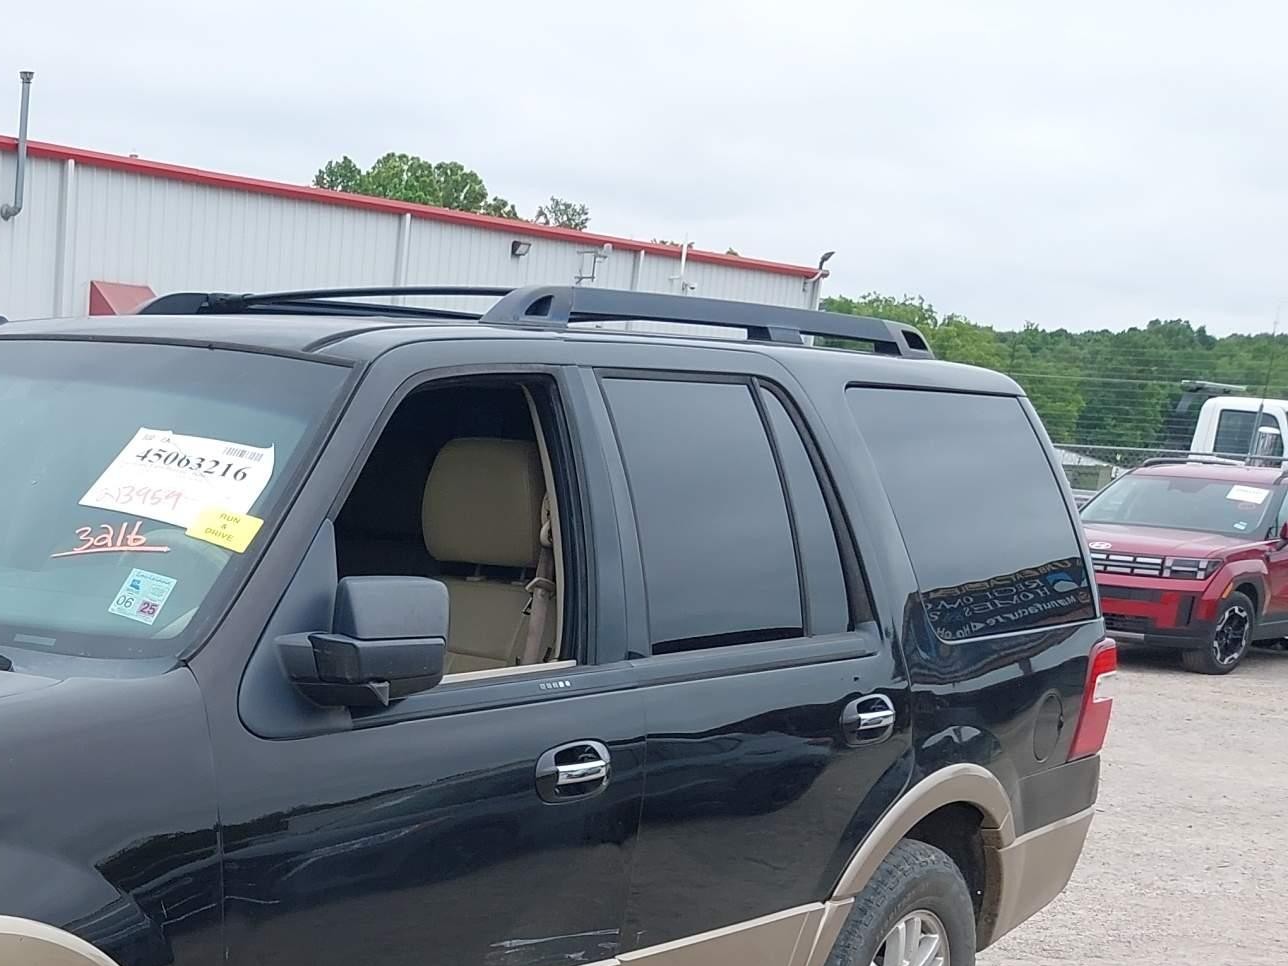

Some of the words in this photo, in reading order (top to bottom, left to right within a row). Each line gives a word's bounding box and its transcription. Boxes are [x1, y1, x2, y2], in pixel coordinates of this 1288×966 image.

[136, 448, 253, 482] 45063216
[219, 512, 241, 525] RUN
[204, 528, 235, 543] DRIVE
[116, 594, 135, 609] 06
[140, 602, 158, 616] 25
